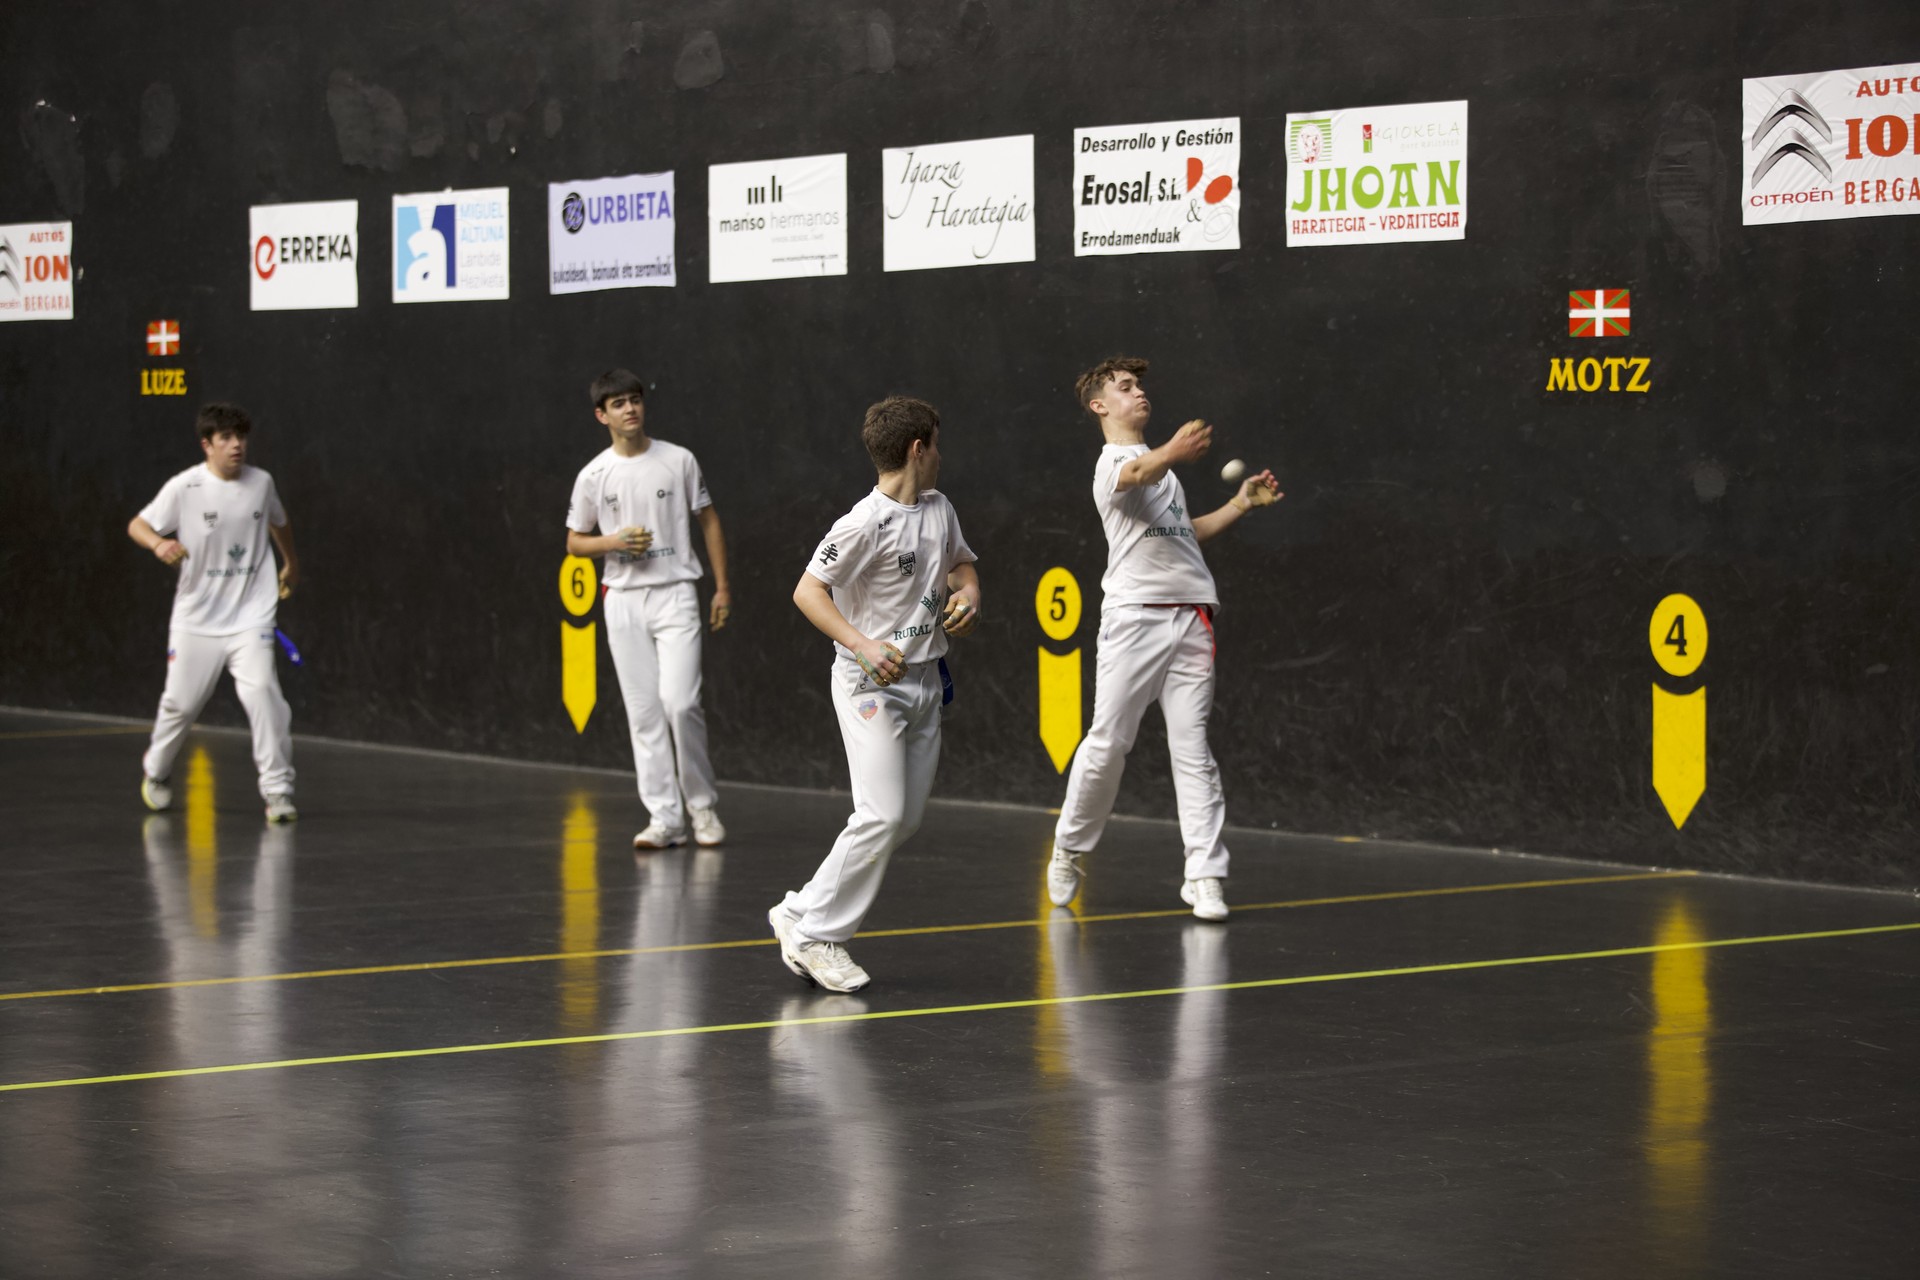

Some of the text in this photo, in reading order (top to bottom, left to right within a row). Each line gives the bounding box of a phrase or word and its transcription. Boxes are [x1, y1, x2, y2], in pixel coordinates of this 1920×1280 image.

[1081, 128, 1234, 153] Desarrollo y Gestión
[1291, 160, 1461, 213] JHOAN
[1844, 177, 1920, 205] BERGA
[460, 201, 505, 219] MIGUEL
[588, 191, 672, 225] URBIETA
[460, 225, 505, 243] ALTUNA
[719, 211, 840, 233] manso hermanos
[926, 190, 1031, 259] Harategia
[1292, 217, 1366, 235] HARATEGIA
[30, 231, 64, 243] AUTOS
[280, 234, 353, 264] ERREKA
[1081, 227, 1181, 248] Errodamenduak
[24, 255, 70, 283] ION
[24, 295, 71, 311] BERGARA
[141, 369, 187, 395] LUZE
[1546, 357, 1651, 392] MOTZ
[1144, 526, 1178, 538] RURAL
[572, 567, 585, 598] 6
[1050, 586, 1066, 620] 5
[894, 624, 932, 641] RURAL
[1664, 614, 1687, 656] 4
